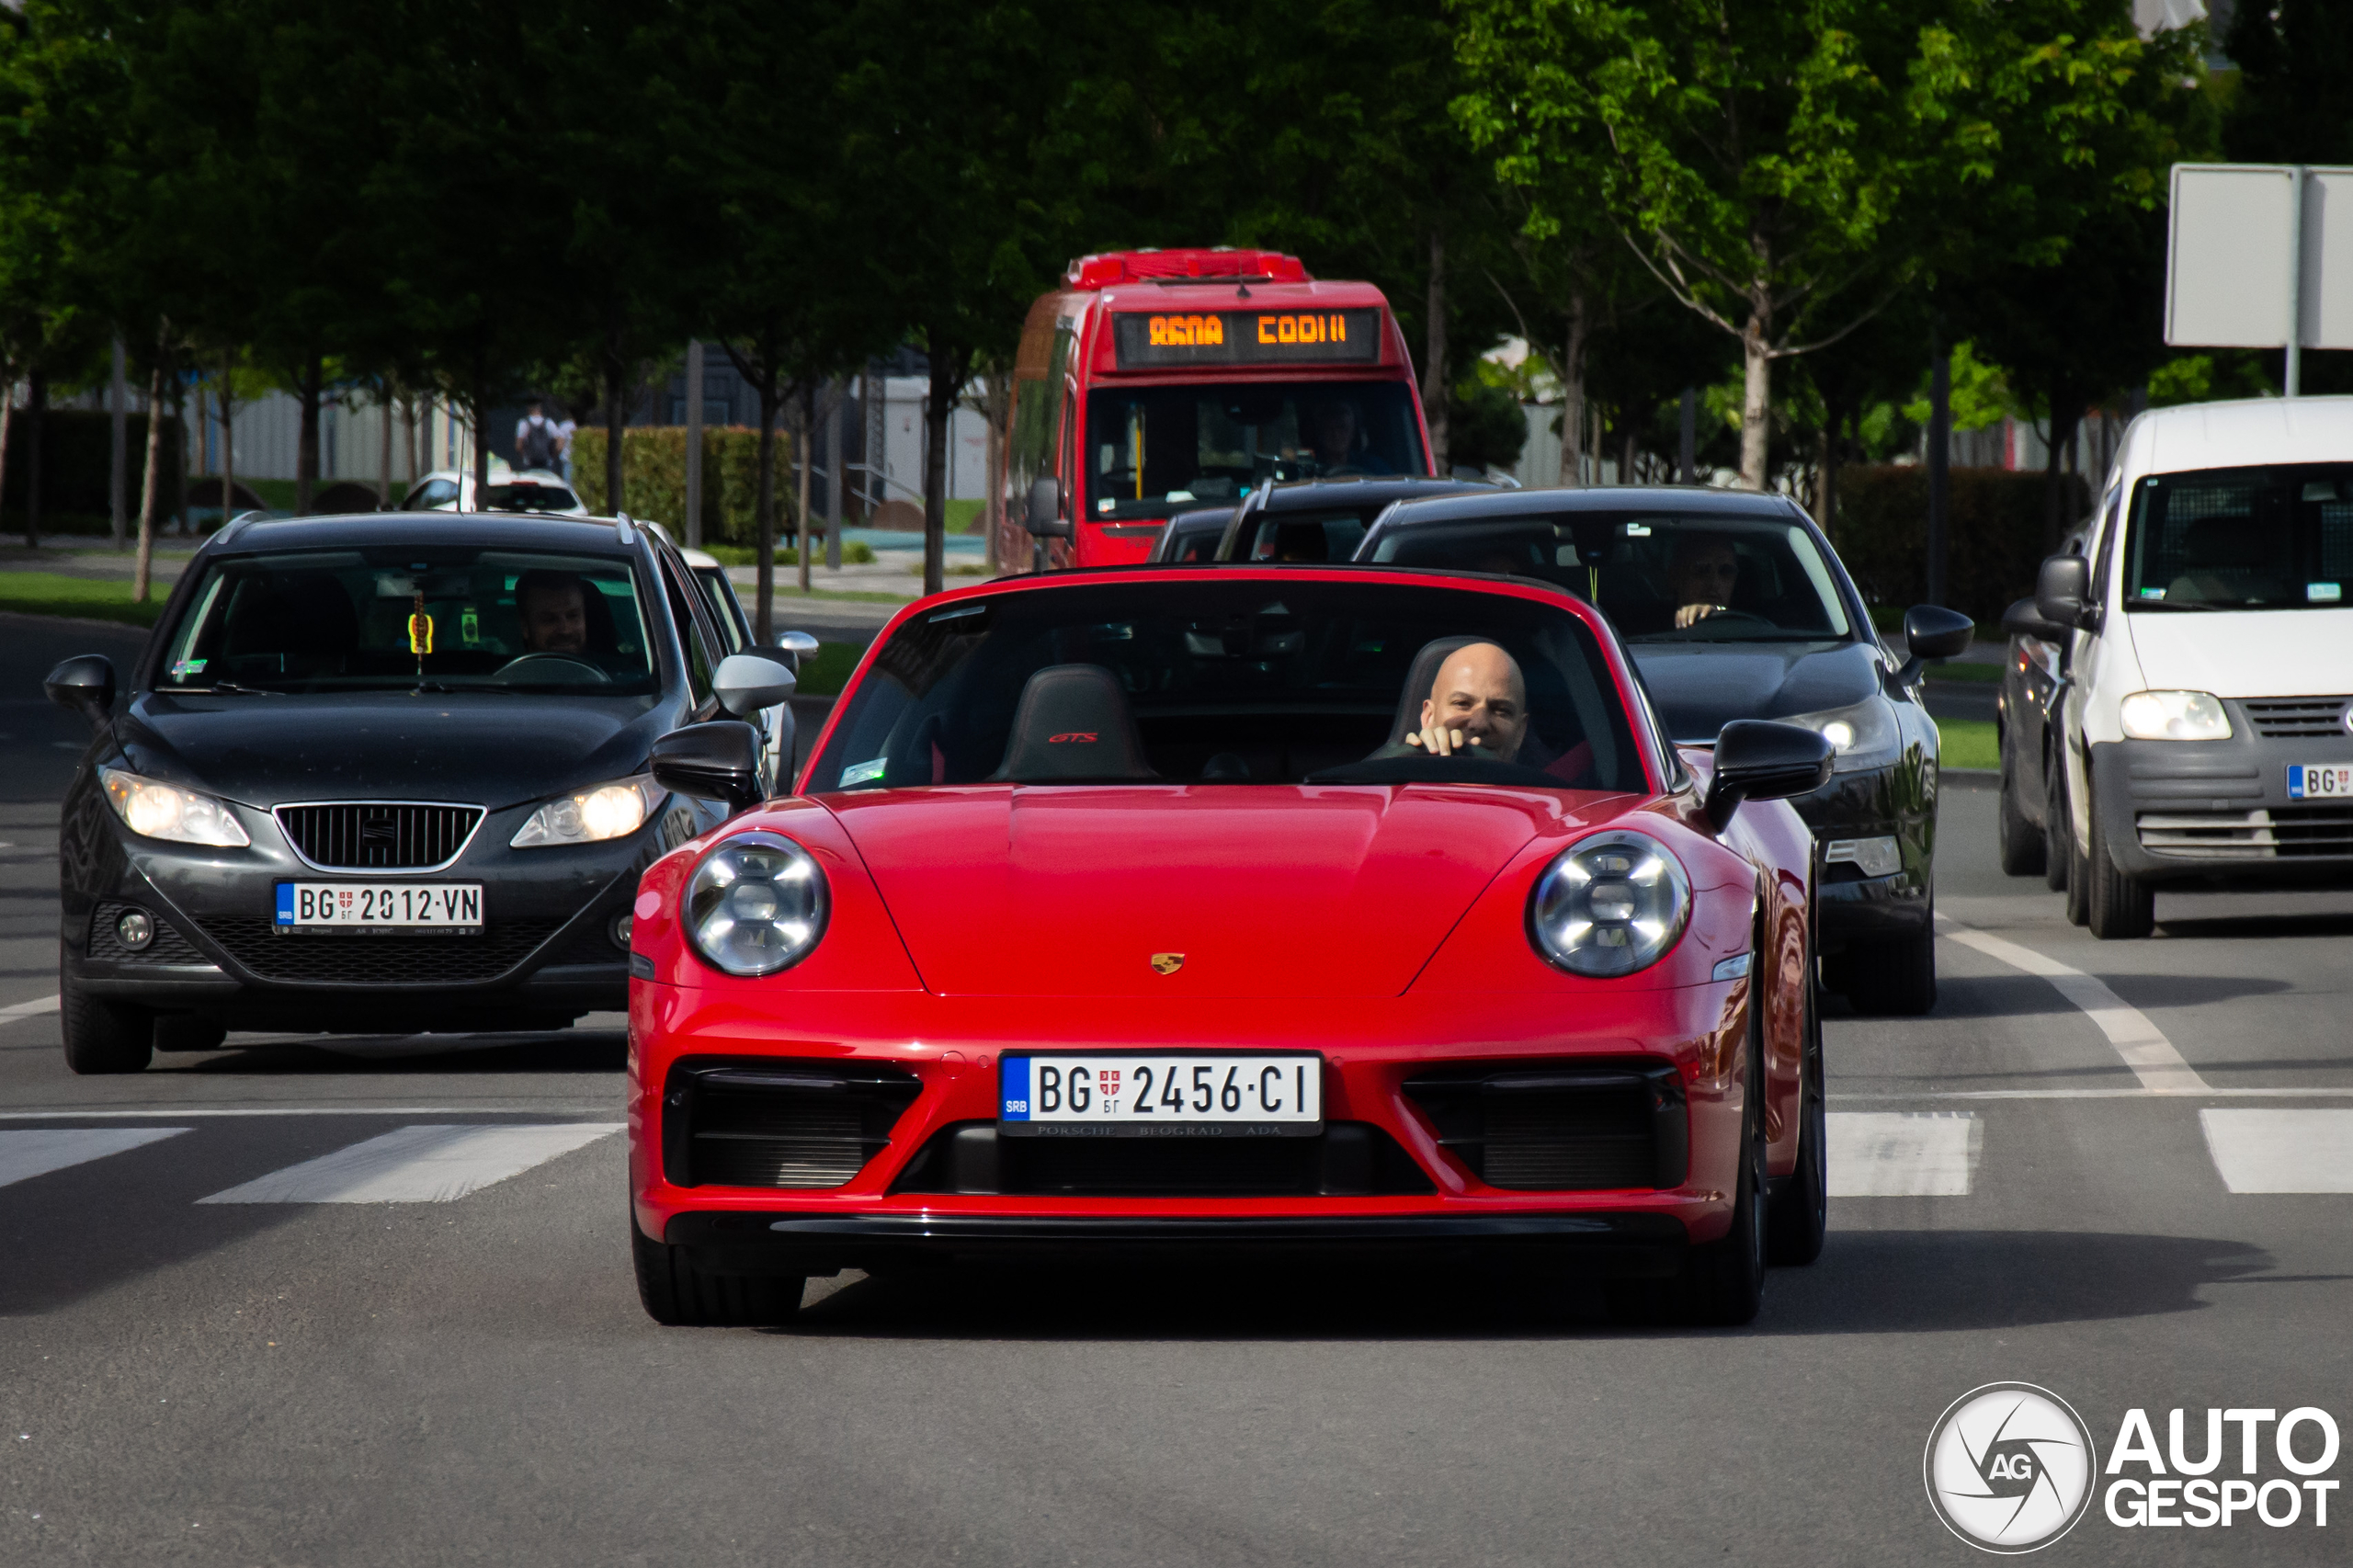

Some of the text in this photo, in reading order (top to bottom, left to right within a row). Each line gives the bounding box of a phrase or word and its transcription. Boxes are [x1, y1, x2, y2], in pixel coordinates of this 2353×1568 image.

[1049, 733, 1098, 743] GTS
[2308, 769, 2334, 793] BG
[300, 889, 335, 920] BG
[1039, 1065, 1091, 1113] BG
[1006, 1101, 1028, 1113] SRB
[1038, 1126, 1283, 1136] PORSCHE BEOGRAD ADA
